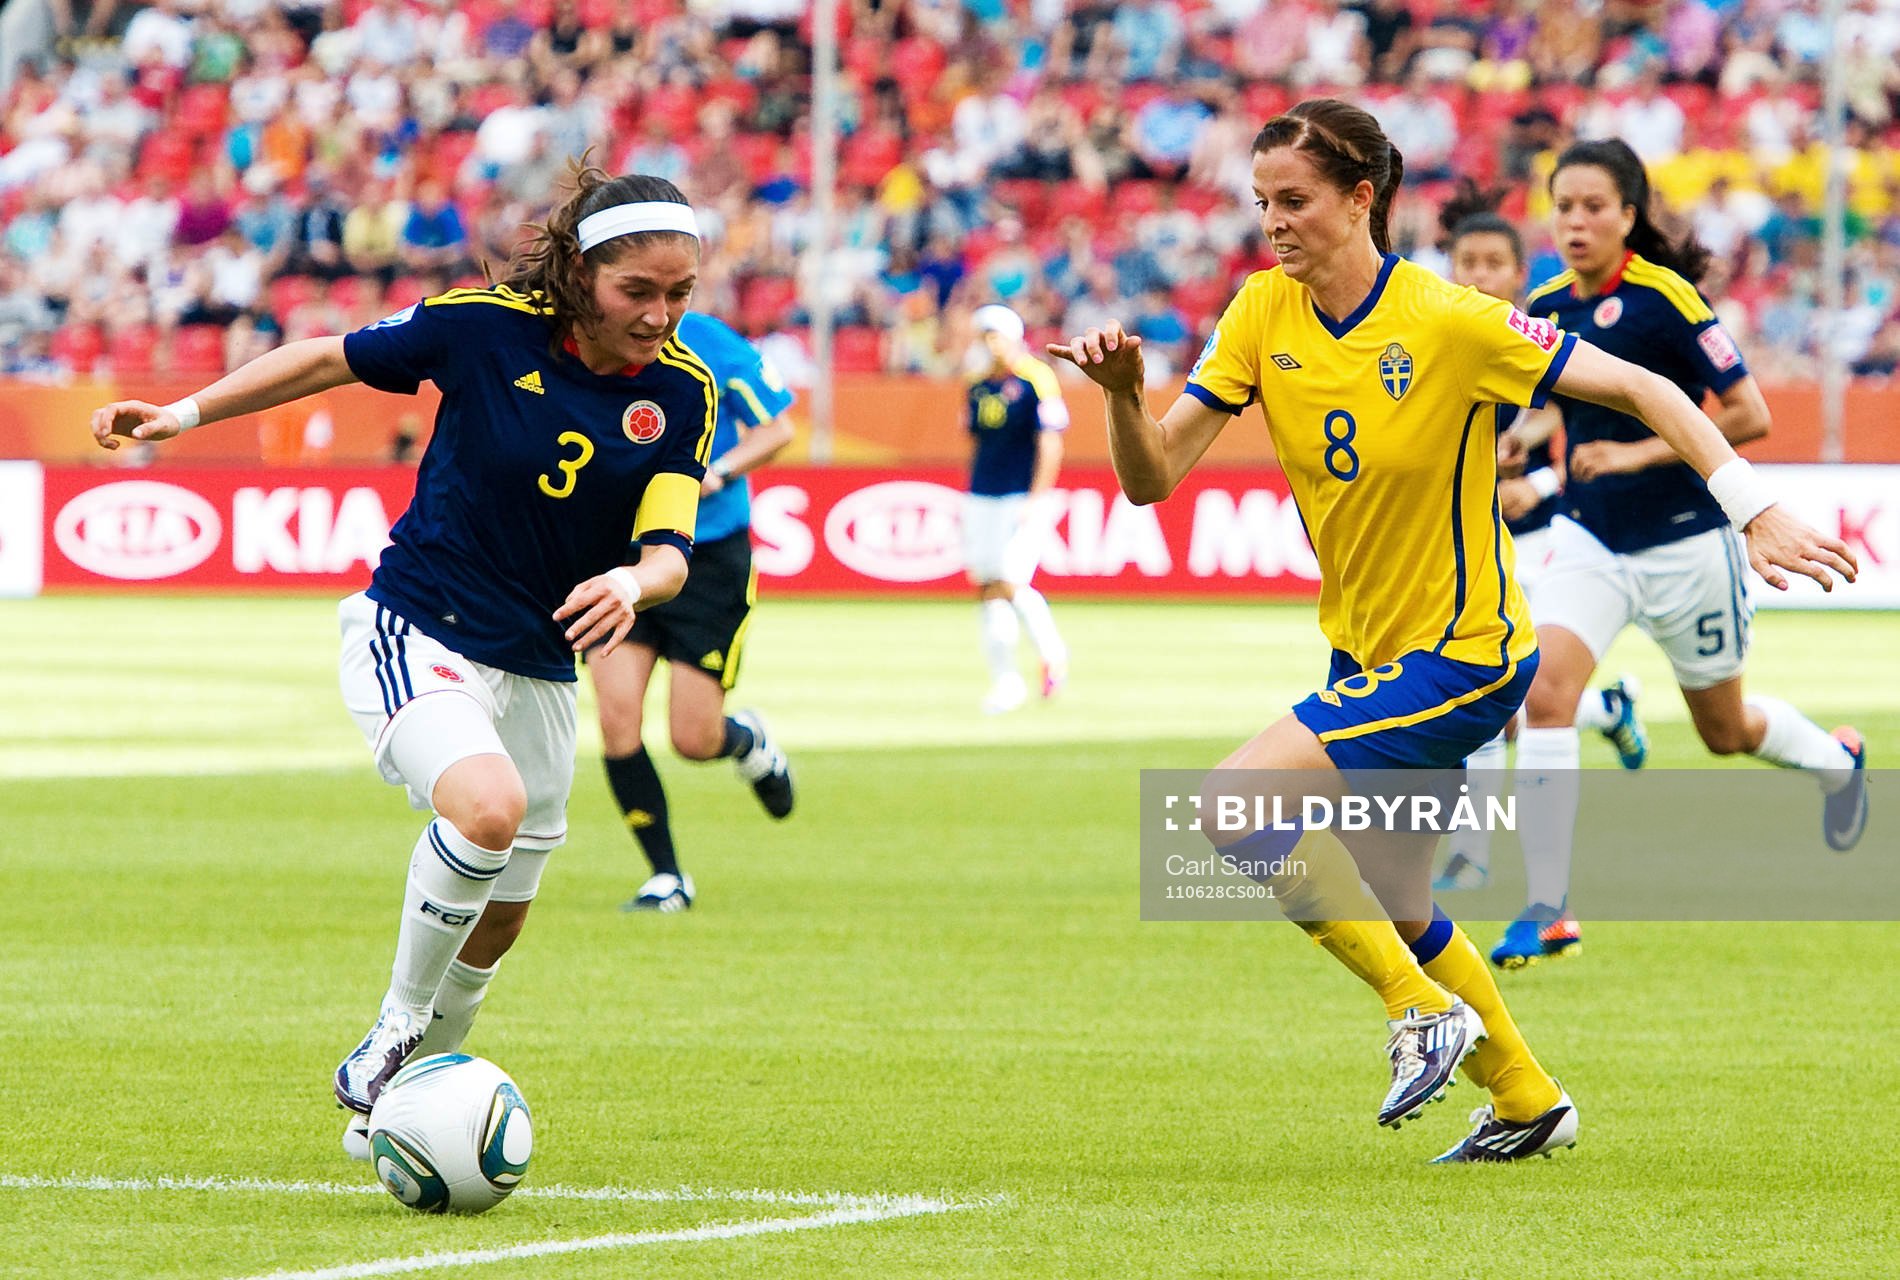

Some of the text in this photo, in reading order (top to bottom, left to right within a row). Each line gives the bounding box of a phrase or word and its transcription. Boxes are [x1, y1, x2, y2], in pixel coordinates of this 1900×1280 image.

[513, 379, 545, 395] adidas
[538, 431, 595, 498] 3
[1324, 409, 1360, 482] 8
[233, 487, 393, 573] KIA
[1697, 610, 1723, 657] 5
[1333, 661, 1404, 698] 8
